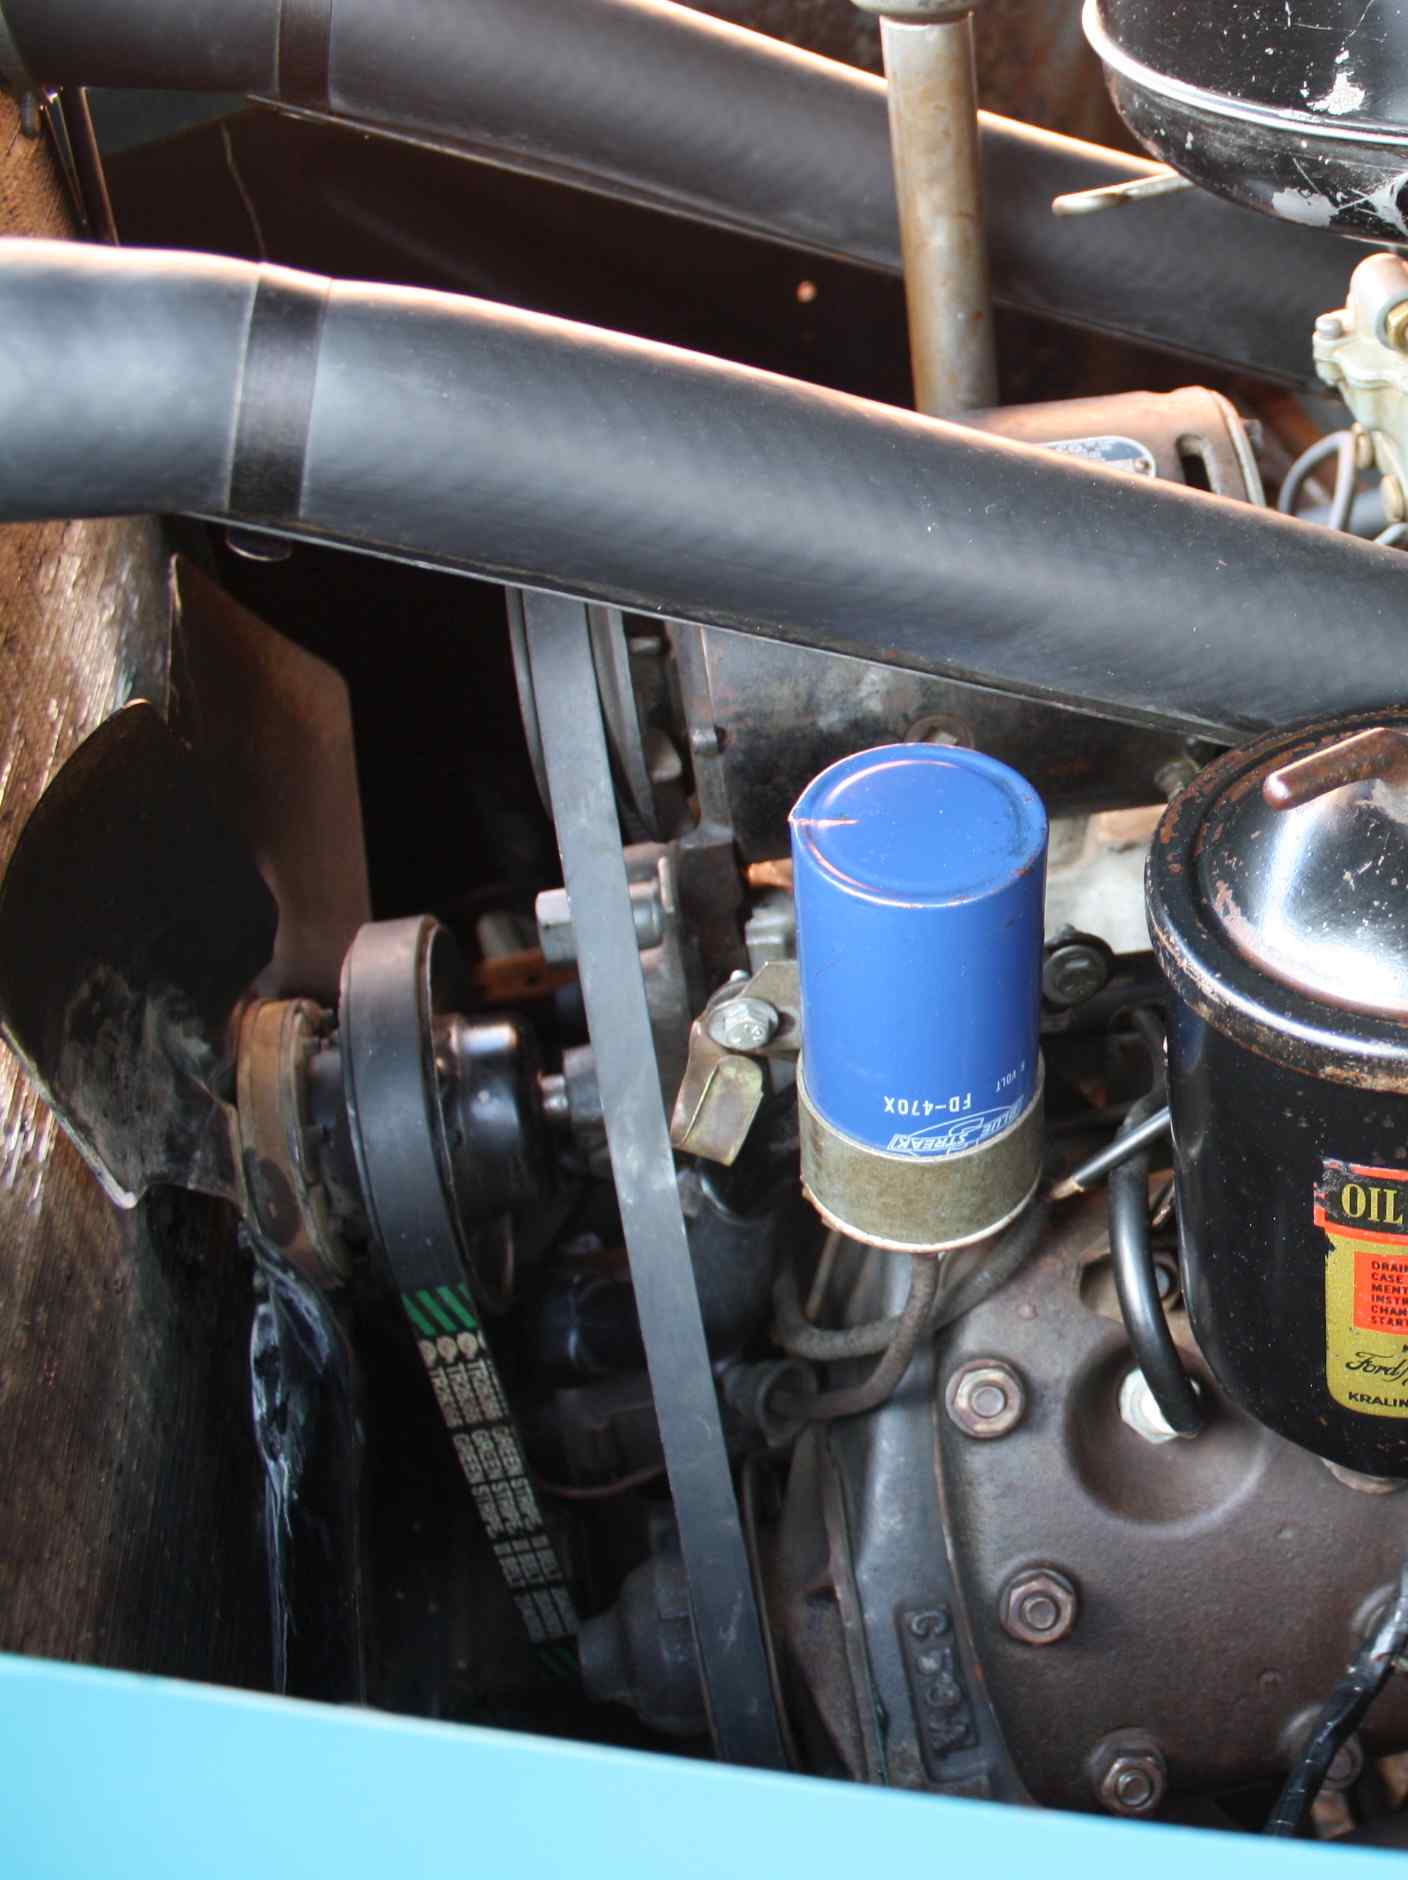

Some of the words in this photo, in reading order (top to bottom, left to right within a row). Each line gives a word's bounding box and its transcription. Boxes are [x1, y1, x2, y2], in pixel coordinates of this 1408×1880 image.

[884, 1092, 972, 1117] FD-470X
[894, 1130, 970, 1152] STREAK
[1341, 1183, 1404, 1226] OIL
[1370, 1272, 1405, 1284] CASE
[1370, 1283, 1408, 1295] MENT
[1345, 1350, 1407, 1382] Ford
